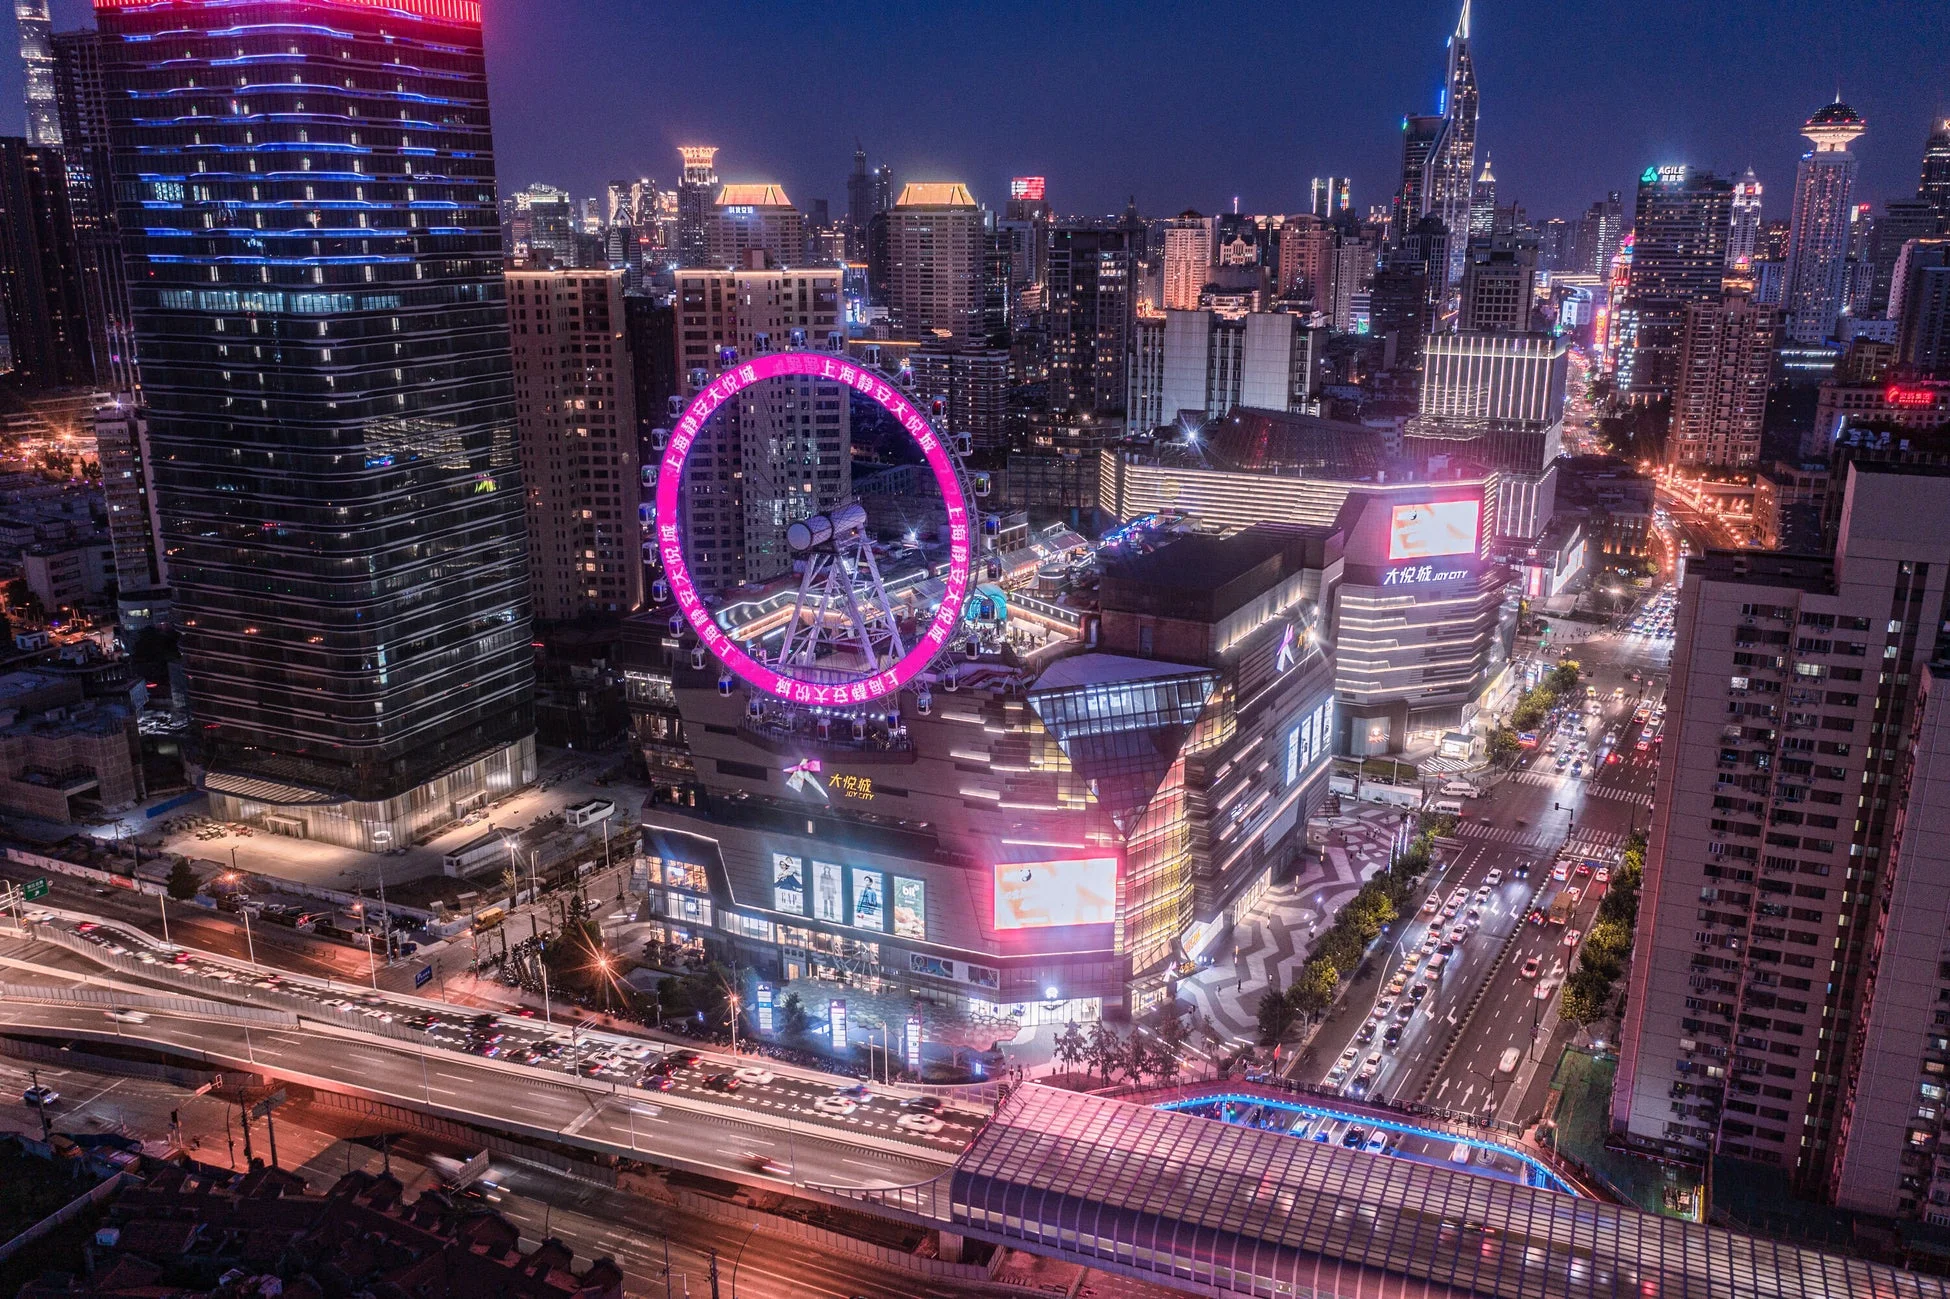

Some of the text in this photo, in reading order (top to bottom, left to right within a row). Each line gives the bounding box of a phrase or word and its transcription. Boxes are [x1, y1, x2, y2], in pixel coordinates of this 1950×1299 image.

[1657, 165, 1686, 175] AGILE
[820, 360, 937, 454] 上海静安大悦城
[666, 364, 758, 474] 上海静安大悦城
[1383, 565, 1433, 585] 大悦城
[775, 668, 899, 704] 上海静安大悦城
[828, 773, 872, 793] 大悦城
[859, 792, 875, 800] CITY
[781, 892, 797, 905] GAP
